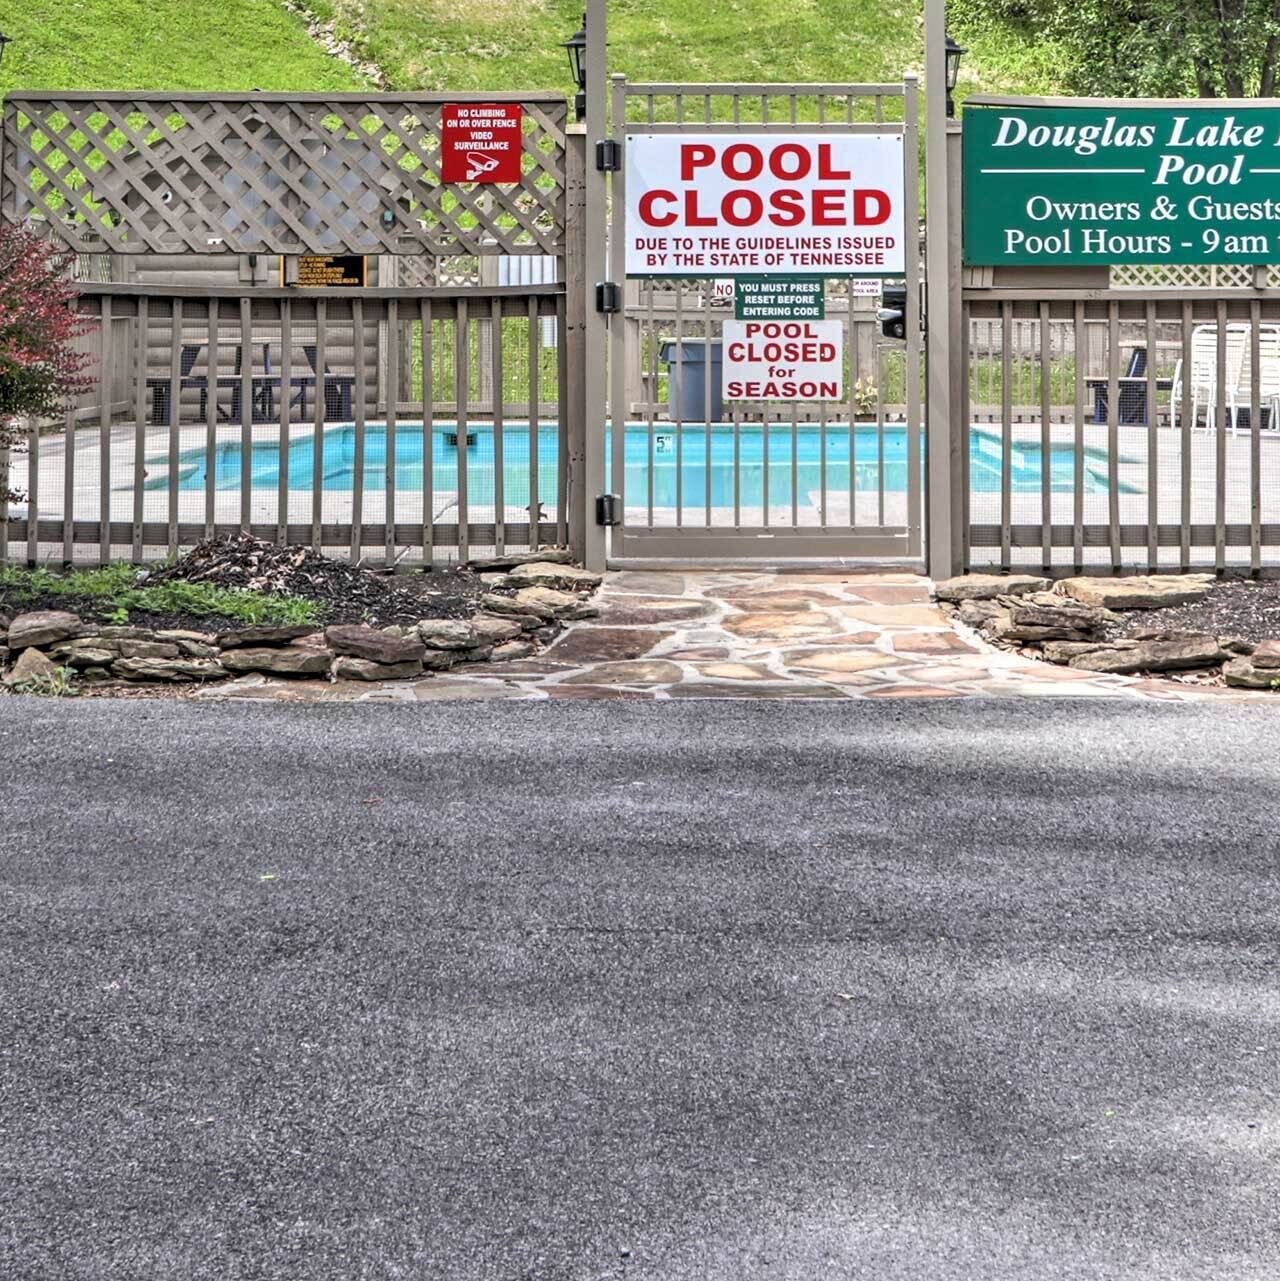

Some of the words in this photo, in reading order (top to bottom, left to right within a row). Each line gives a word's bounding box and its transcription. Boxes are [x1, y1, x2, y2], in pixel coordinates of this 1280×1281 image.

[457, 108, 469, 118] NO
[470, 108, 506, 118] CLIMBING
[447, 119, 458, 128] ON
[459, 119, 470, 128] OR
[471, 119, 492, 128] OVER
[493, 119, 517, 128] FENCE
[470, 131, 493, 140] VIDEO
[991, 116, 1156, 156] Douglas
[1165, 116, 1265, 148] Lake
[454, 141, 509, 150] SURVEILLANCE
[680, 143, 852, 182] POOL
[1152, 154, 1245, 186] Pool
[638, 188, 893, 228] CLOSED
[1026, 195, 1141, 221] Owners
[1150, 195, 1178, 221] &
[635, 237, 668, 251] DUE
[672, 237, 694, 251] TO
[698, 237, 731, 251] THE
[735, 237, 832, 251] GUIDELINES
[837, 236, 895, 250] ISSUED
[1004, 228, 1072, 254] Pool
[1081, 229, 1172, 254] Hours
[1202, 228, 1270, 254] 9am
[646, 253, 668, 266] BY
[672, 253, 705, 266] THE
[709, 253, 759, 266] STATE
[764, 253, 785, 266] OF
[789, 252, 885, 266] TENNESSEE
[716, 284, 733, 296] NO
[738, 283, 759, 293] YOU
[761, 283, 788, 293] MUST
[790, 283, 821, 293] PRESS
[744, 295, 776, 304] RESET
[777, 295, 815, 304] BEFORE
[743, 307, 792, 316] ENTERING
[793, 307, 820, 316] CODE
[746, 323, 818, 339] POOL
[728, 342, 836, 363] CLOSED
[768, 366, 796, 378] for
[727, 382, 837, 398] SEASON
